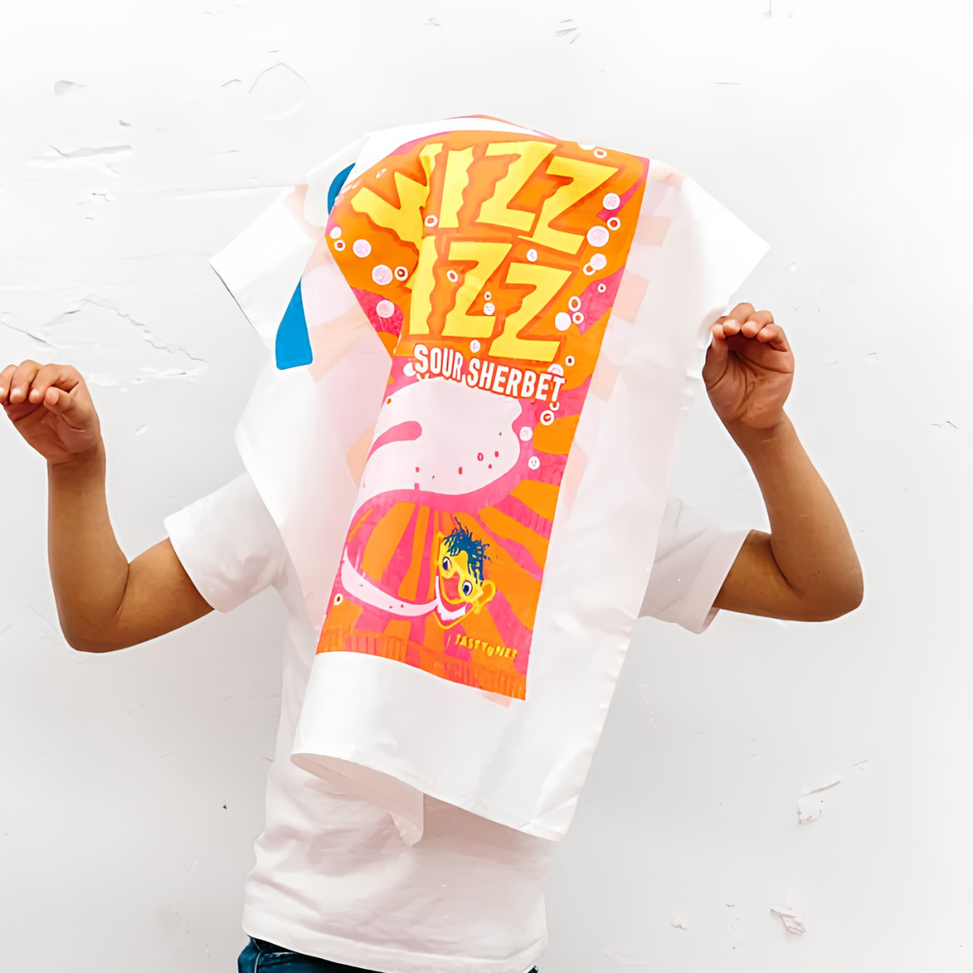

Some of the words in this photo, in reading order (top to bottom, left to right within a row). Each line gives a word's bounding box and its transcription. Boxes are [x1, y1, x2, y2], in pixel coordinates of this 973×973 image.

[350, 140, 619, 255] WIZZ
[404, 235, 573, 362] IZZ
[413, 344, 464, 381] SOUR
[467, 357, 566, 402] SHERBET
